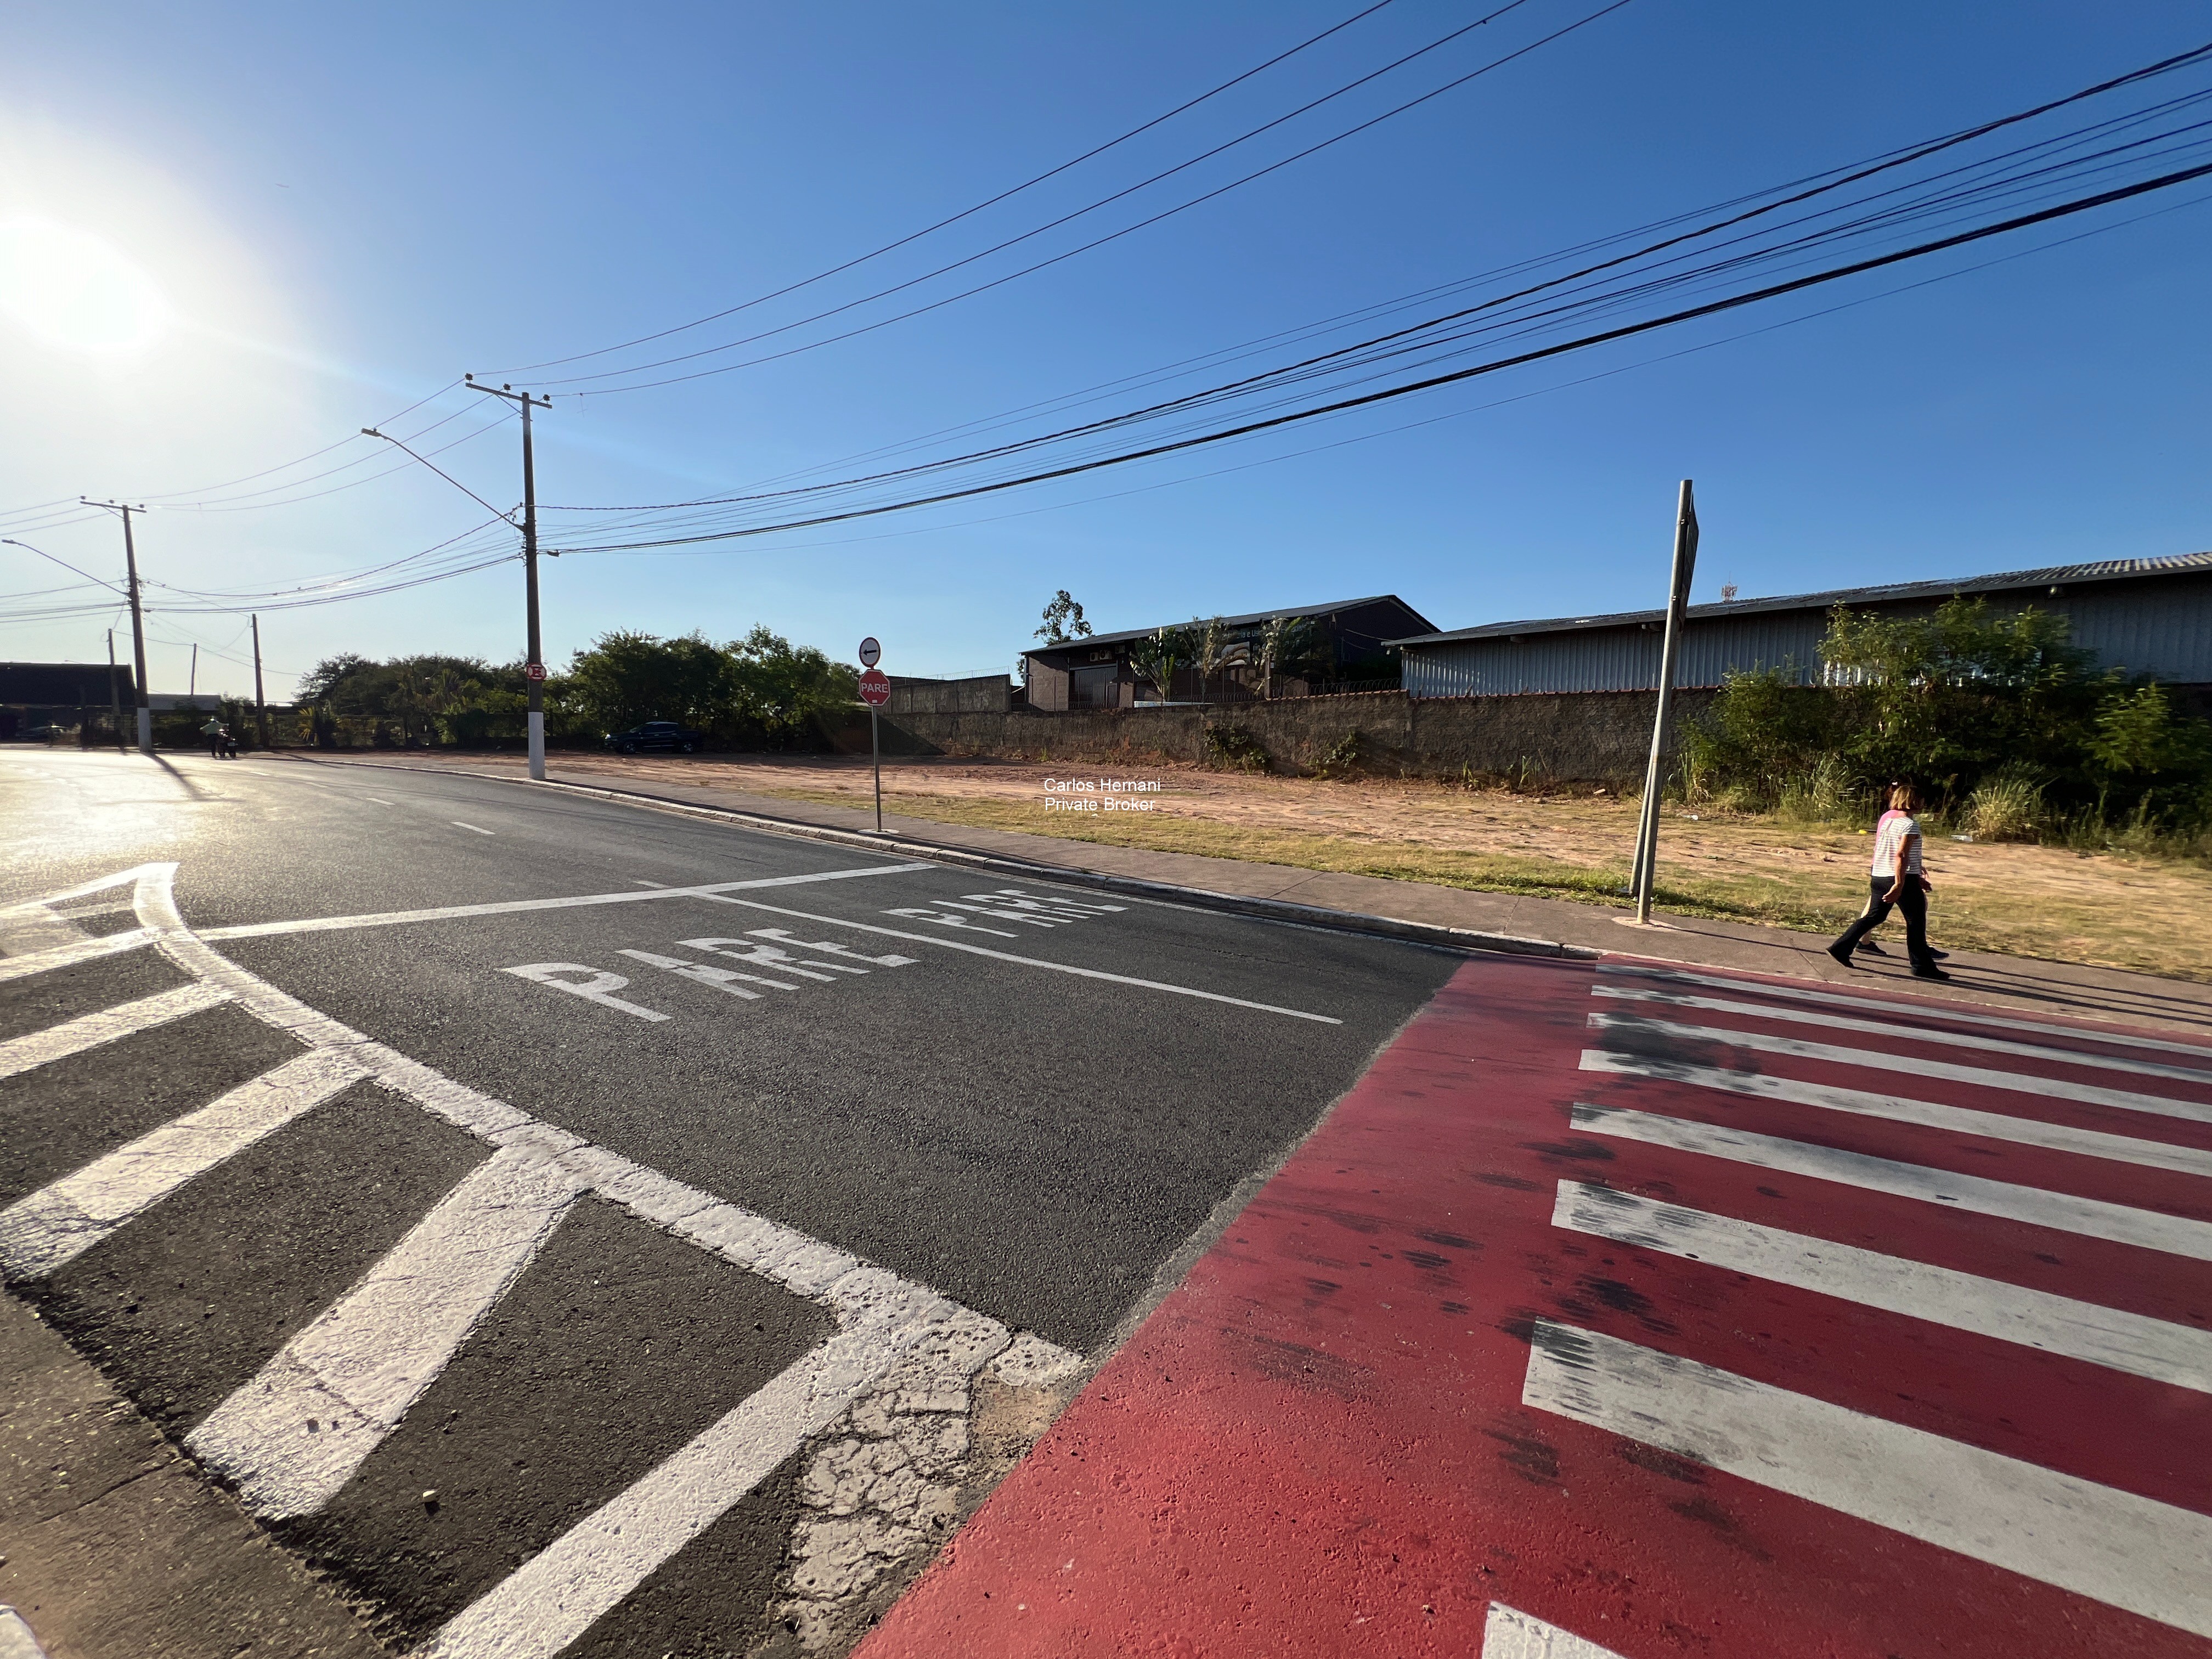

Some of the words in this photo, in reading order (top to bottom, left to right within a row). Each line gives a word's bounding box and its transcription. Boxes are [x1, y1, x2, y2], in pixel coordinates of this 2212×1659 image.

[861, 682, 888, 693] PARE
[879, 889, 1130, 938] PARE
[495, 927, 921, 1022] PARE
